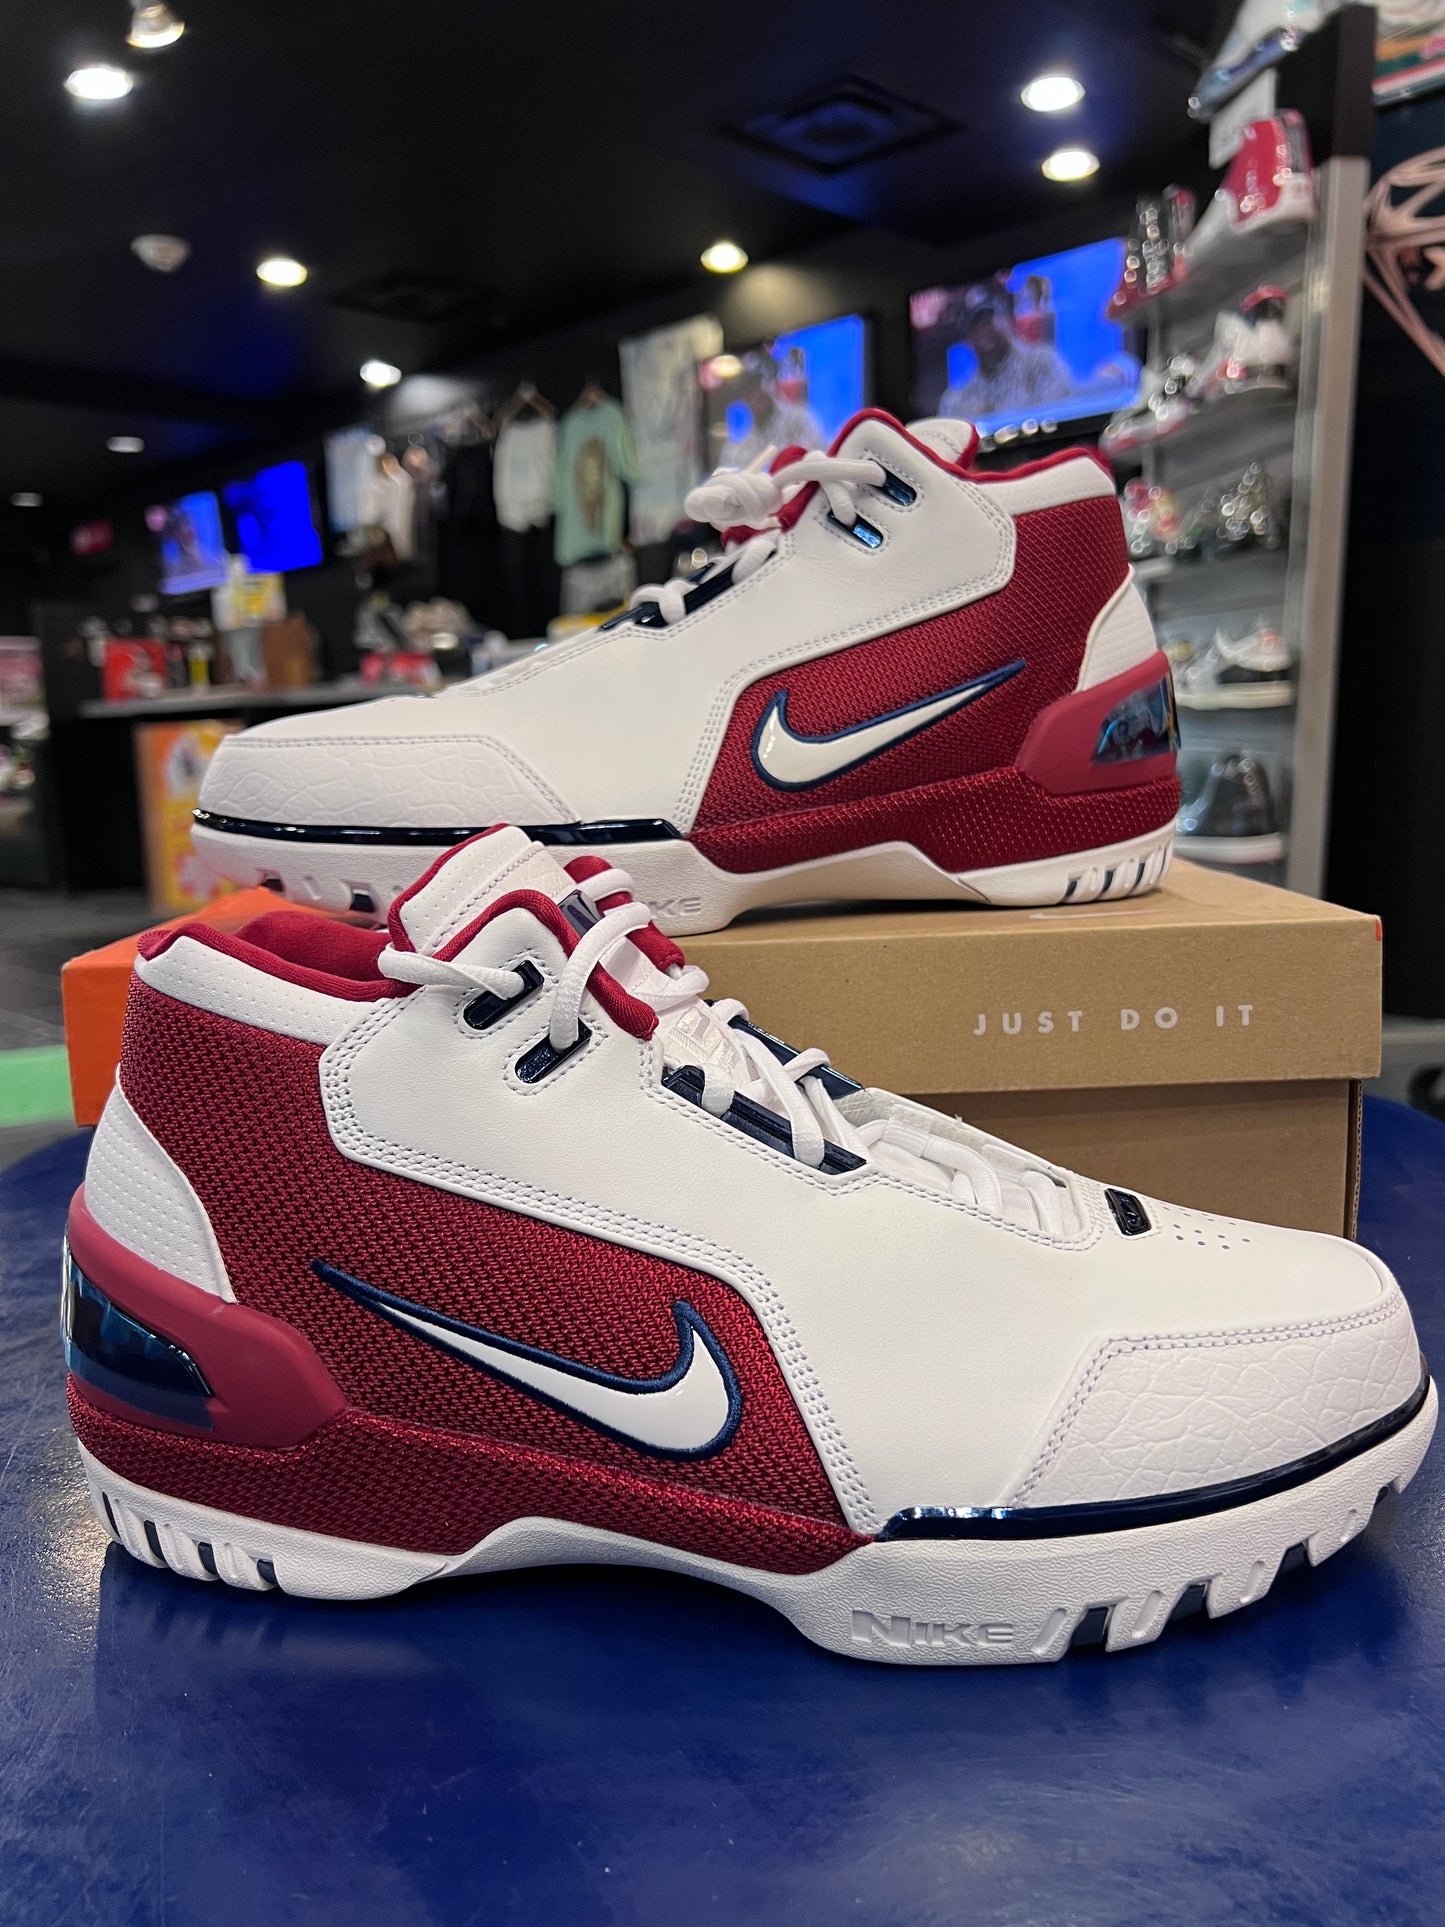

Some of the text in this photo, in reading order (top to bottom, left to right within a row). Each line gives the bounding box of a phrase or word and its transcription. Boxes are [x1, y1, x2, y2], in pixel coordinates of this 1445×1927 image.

[648, 896, 702, 919] KE
[972, 1003, 1254, 1036] JUST DO IT
[851, 1609, 1014, 1648] NIKE
